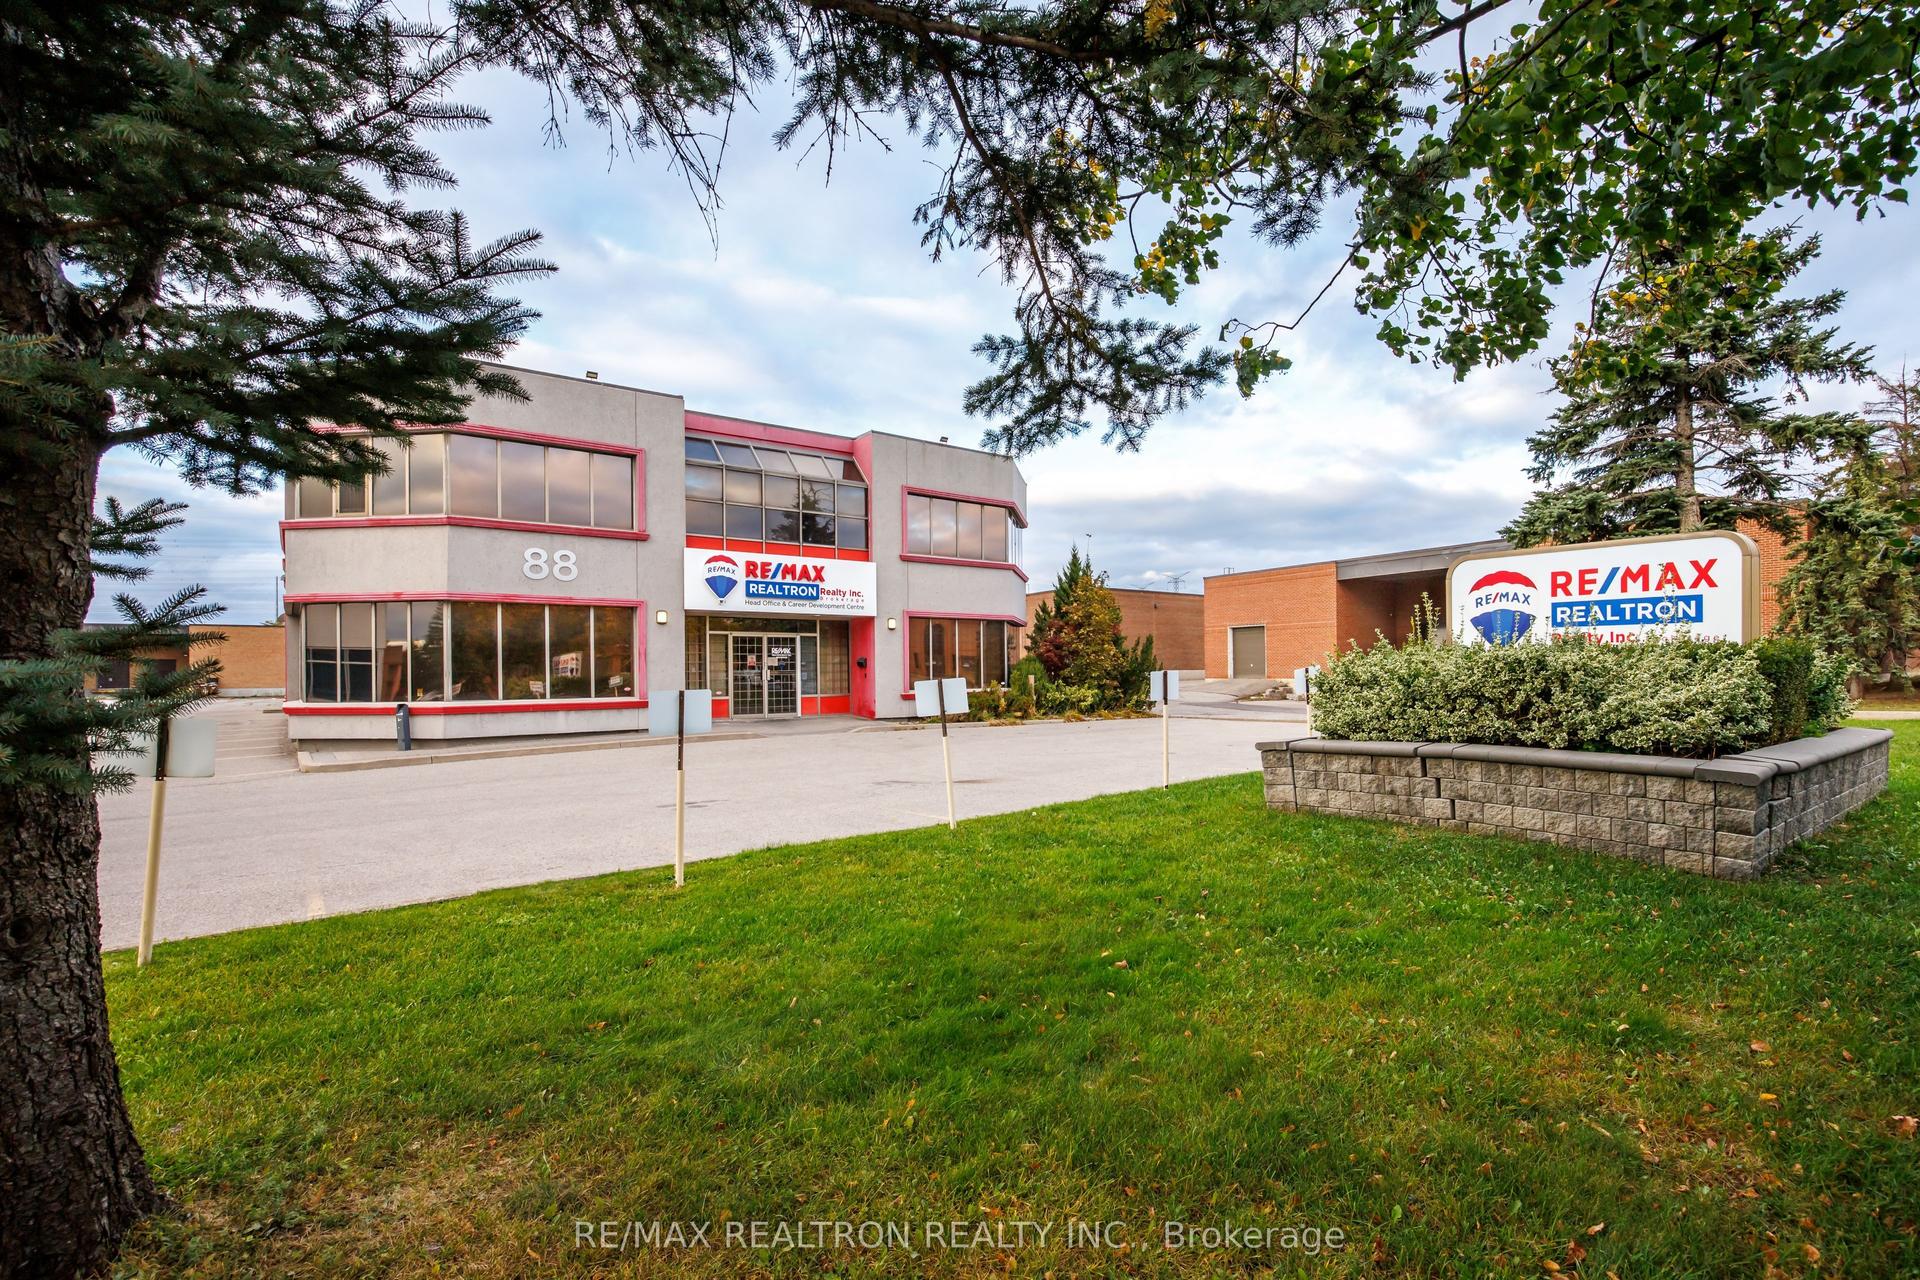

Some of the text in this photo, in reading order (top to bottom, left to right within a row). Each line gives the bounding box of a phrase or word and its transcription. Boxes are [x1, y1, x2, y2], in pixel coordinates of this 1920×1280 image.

[523, 547, 579, 581] 88
[707, 566, 736, 575] RE/MAX
[745, 560, 825, 582] RE/MAX
[1551, 558, 1719, 598] RE/MAX
[749, 583, 864, 597] REALTRON Realty Inc.
[1475, 591, 1531, 608] RE/MAX
[809, 602, 845, 610] Development
[1556, 600, 1696, 623] REALTRON
